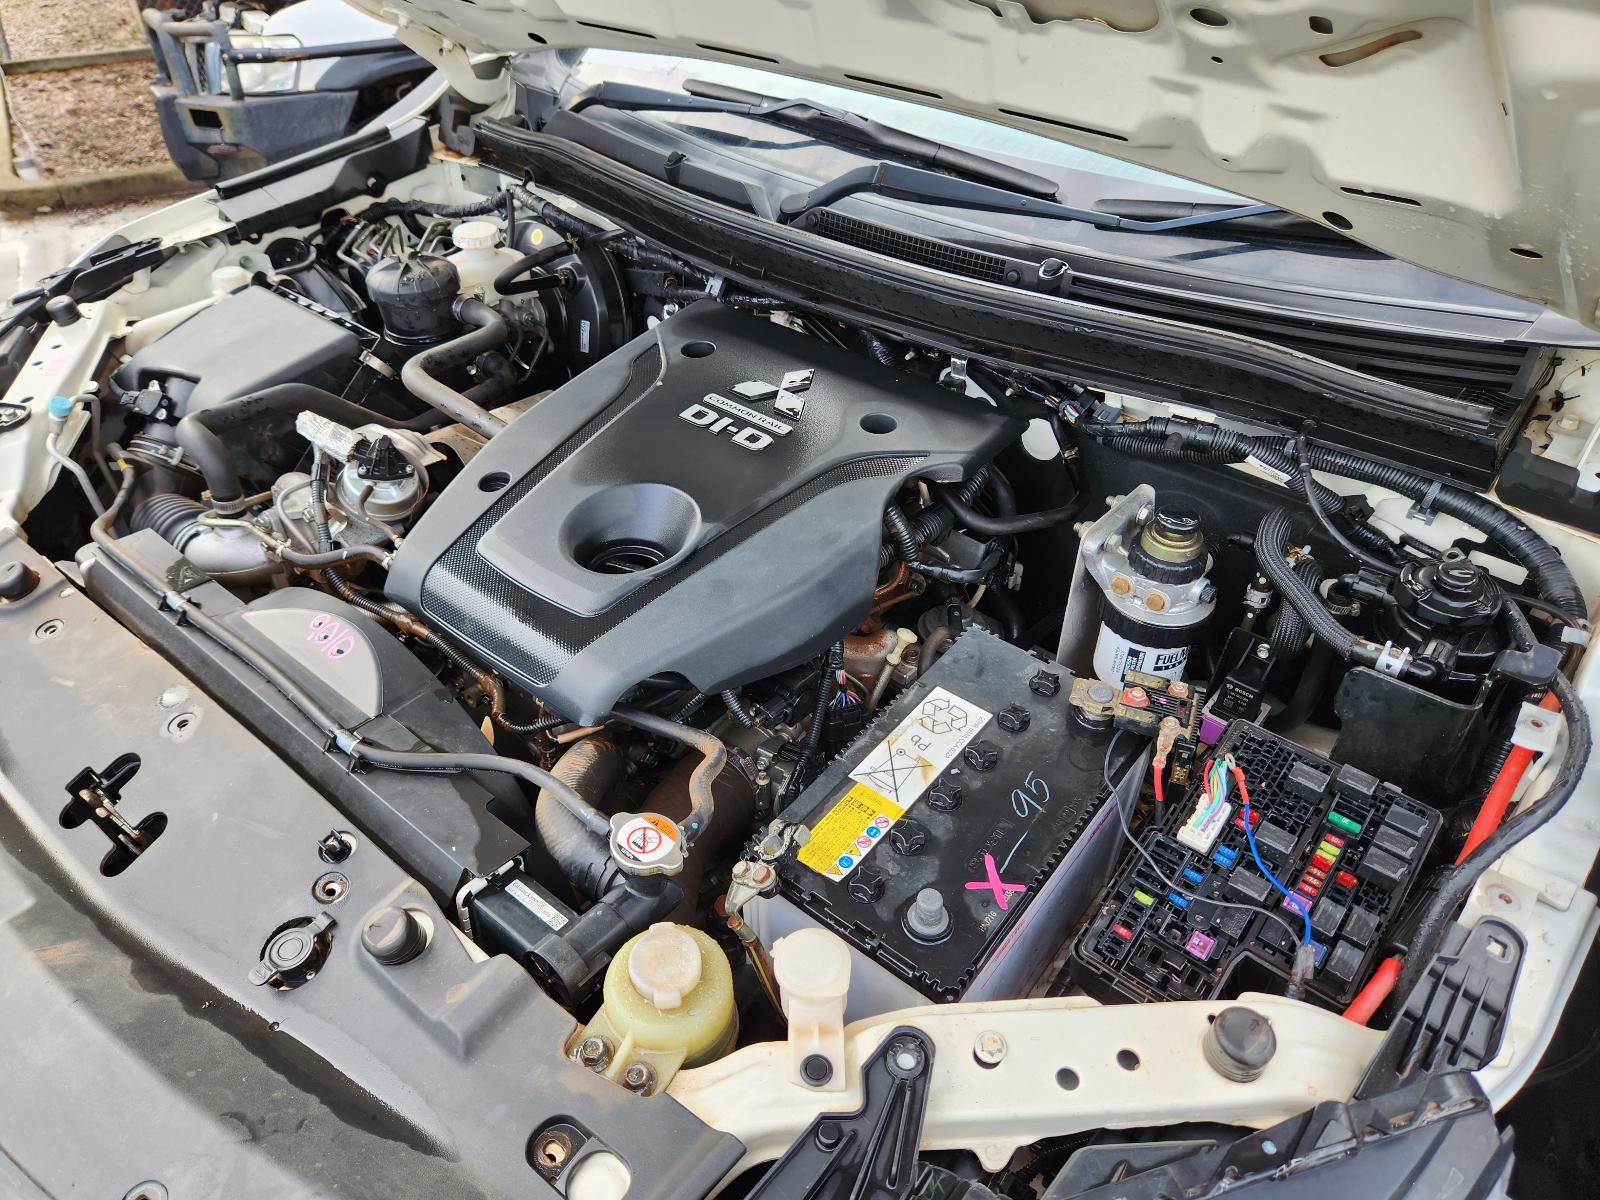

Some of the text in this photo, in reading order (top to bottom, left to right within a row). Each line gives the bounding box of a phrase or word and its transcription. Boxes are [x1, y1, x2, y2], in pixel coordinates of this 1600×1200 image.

[679, 404, 774, 451] DI-D
[709, 397, 786, 432] COMMON RAIL
[1234, 687, 1254, 701] BOSCH
[911, 734, 932, 752] Pb
[1012, 771, 1050, 817] 95
